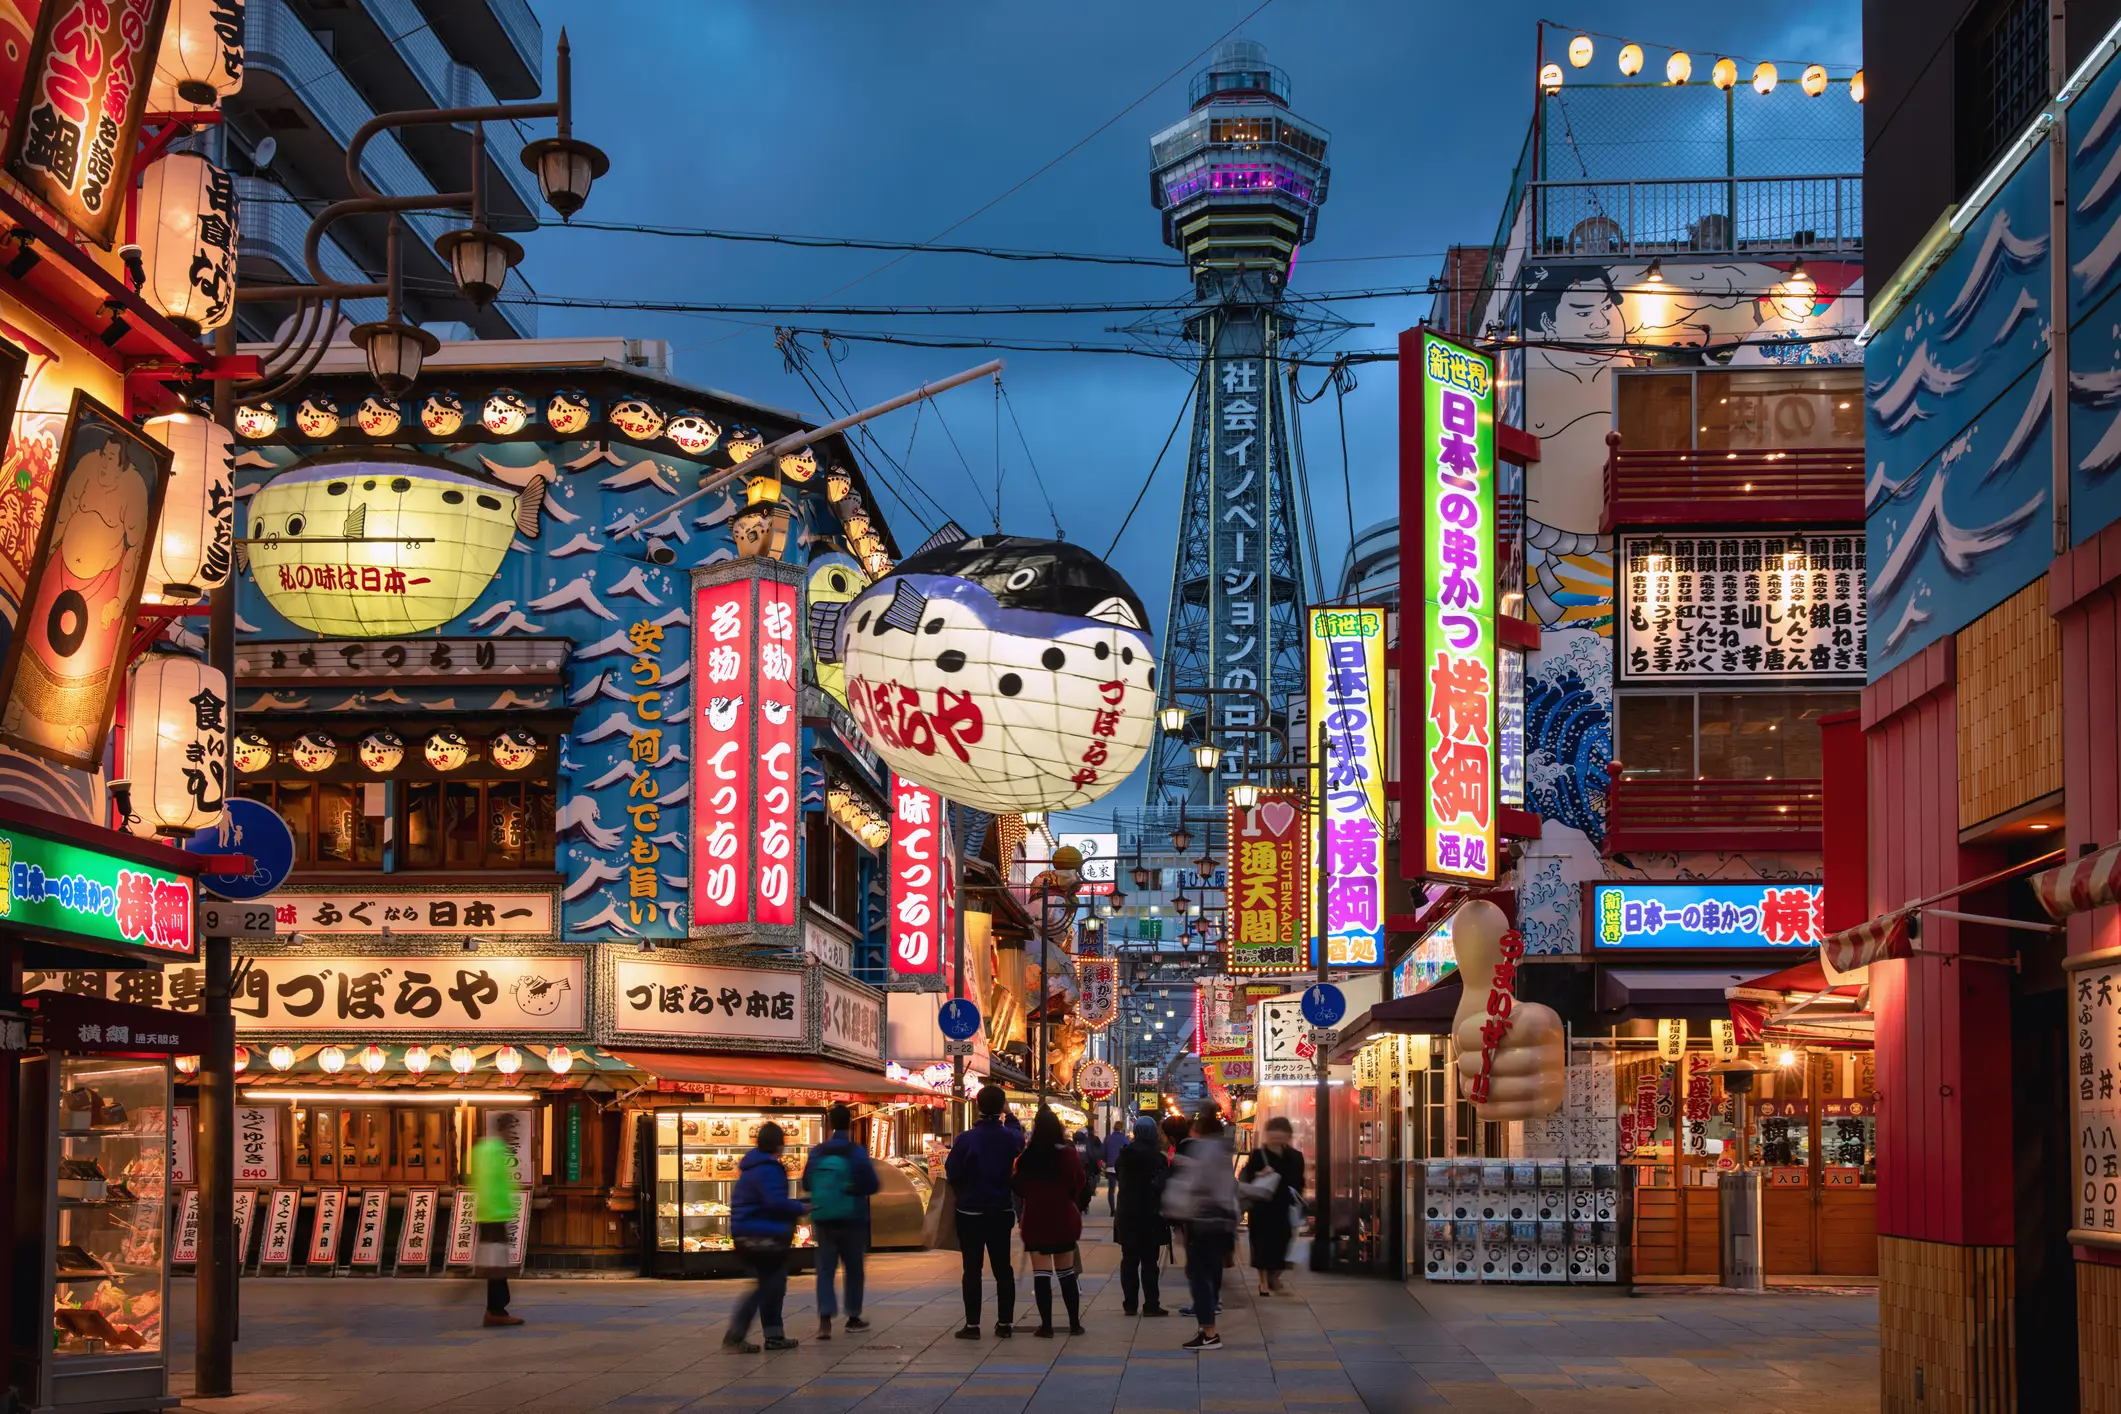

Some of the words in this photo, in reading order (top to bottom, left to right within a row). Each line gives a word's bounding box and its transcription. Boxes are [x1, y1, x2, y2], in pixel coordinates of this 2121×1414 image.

[1428, 343, 1488, 397] 新世界
[1440, 390, 1479, 648] 日本一の串かつ
[278, 564, 431, 595] 私の味は日本一
[708, 600, 741, 684] 名物
[762, 600, 793, 683] 名物
[1315, 614, 1379, 639] 新世界
[1630, 604, 1649, 672] もち
[1652, 604, 1674, 672] うずら玉子
[1675, 604, 1696, 672] 紅しょうが
[1697, 604, 1717, 672] にんにく
[1720, 604, 1740, 672] 玉ねぎ
[1742, 604, 1763, 672] 山芋
[1765, 604, 1786, 672] しし唐
[1787, 604, 1807, 672] れんこん
[1809, 604, 1831, 672] 銀杏
[1833, 604, 1853, 672] 白ねぎ
[1071, 678, 1128, 791] づぼらや
[1430, 653, 1490, 829] 横綱
[627, 619, 665, 926] 安うて何んでも旨い
[707, 741, 740, 907] てっちり
[761, 741, 792, 907] てっちり
[1241, 802, 1262, 838] I
[1438, 832, 1486, 872] 酒処
[13, 862, 115, 916] 日本一の串かつ
[117, 869, 190, 949] 横綱
[897, 777, 932, 966] 味てっちり
[1239, 840, 1278, 945] 通天閣
[1280, 840, 1294, 943] TSUTENKAKU
[206, 911, 219, 930] 9
[244, 912, 271, 931] 22
[312, 901, 533, 928] ふぐなら日本一
[1625, 901, 1757, 933] 日本一の串かつ
[78, 1024, 129, 1044] 横綱
[135, 1033, 180, 1046] 通天閣店
[625, 982, 795, 1021] づぼらや本店
[2096, 974, 2114, 1101] 天丼
[241, 1109, 267, 1165] ふぐゆびき
[242, 1168, 267, 1178] 840
[1778, 1175, 1800, 1184] 入口
[1831, 1175, 1853, 1184] 入口
